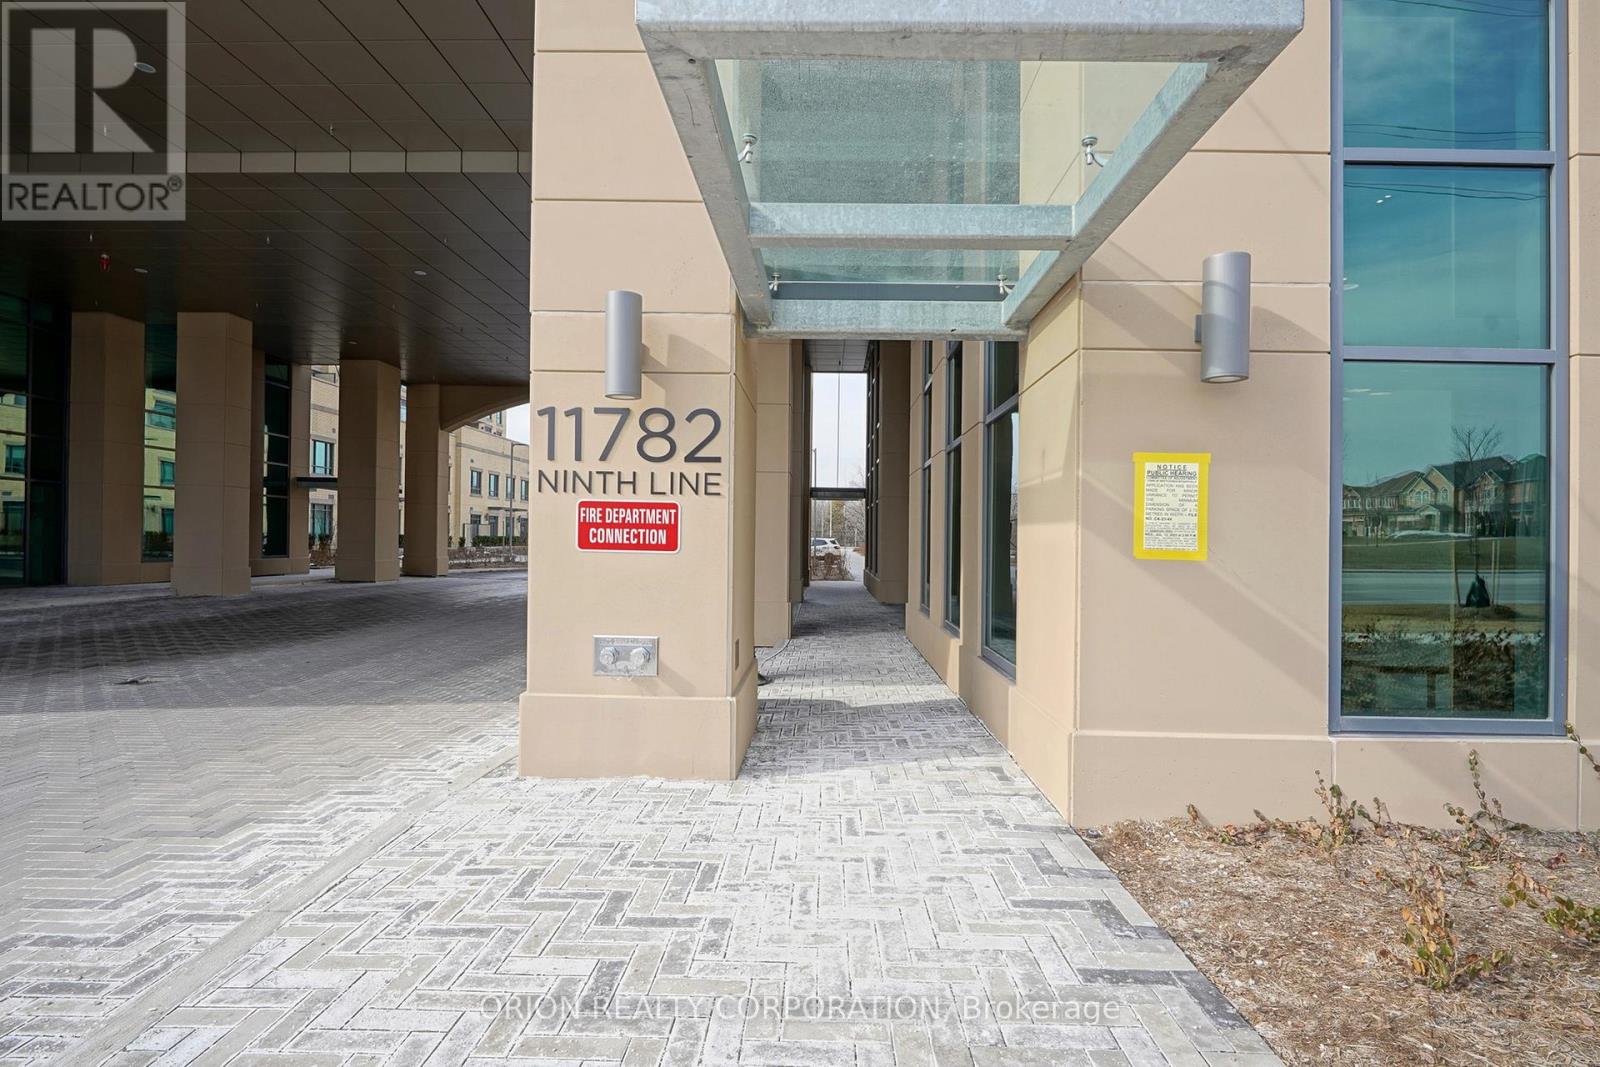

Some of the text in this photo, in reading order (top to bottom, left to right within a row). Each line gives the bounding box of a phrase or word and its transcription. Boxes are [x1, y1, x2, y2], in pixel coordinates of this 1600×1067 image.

[537, 406, 722, 463] 11782
[537, 469, 722, 496] NINTH LINE
[580, 507, 677, 525] FIRE DEPARTMENT
[589, 528, 667, 545] CONNECTION
